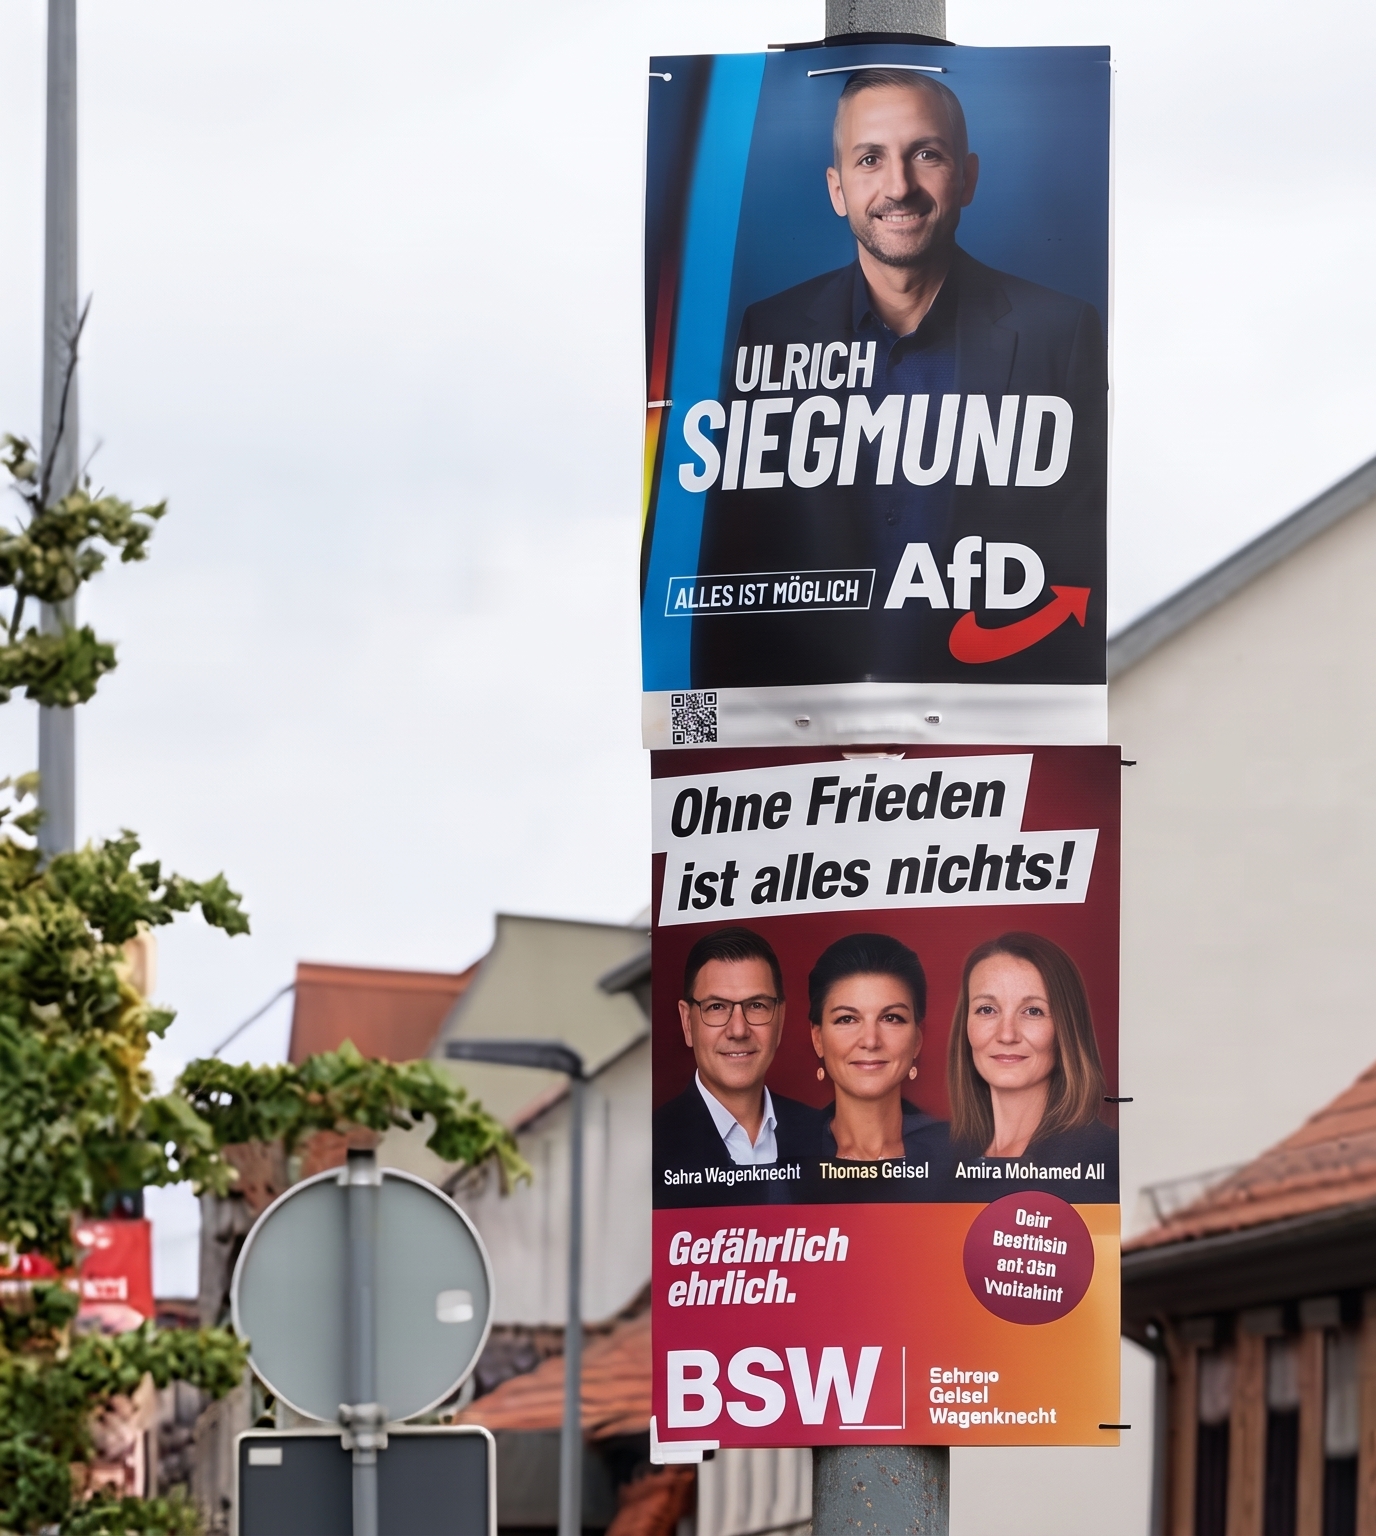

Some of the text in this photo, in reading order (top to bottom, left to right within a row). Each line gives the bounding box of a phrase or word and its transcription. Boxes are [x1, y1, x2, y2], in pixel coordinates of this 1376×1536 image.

[734, 340, 876, 392] ULRICH
[678, 394, 1074, 493] SIEGMUND
[883, 535, 1045, 610] AfD
[674, 576, 859, 610] ALLES IST MÖGLICH
[671, 771, 1006, 838] Ohne Frieden
[677, 840, 1076, 911] ist alles nichts!
[664, 1164, 801, 1187] Sahra Wagenknecht
[819, 1161, 929, 1179] Thomas Geisel
[955, 1162, 1002, 1179] Amira
[1005, 1162, 1081, 1180] Mohamed
[668, 1227, 849, 1266] Gefährlich
[667, 1269, 797, 1307] ehrlich.
[666, 1346, 883, 1429] BSW
[929, 1407, 1057, 1429] Wagenknecht
